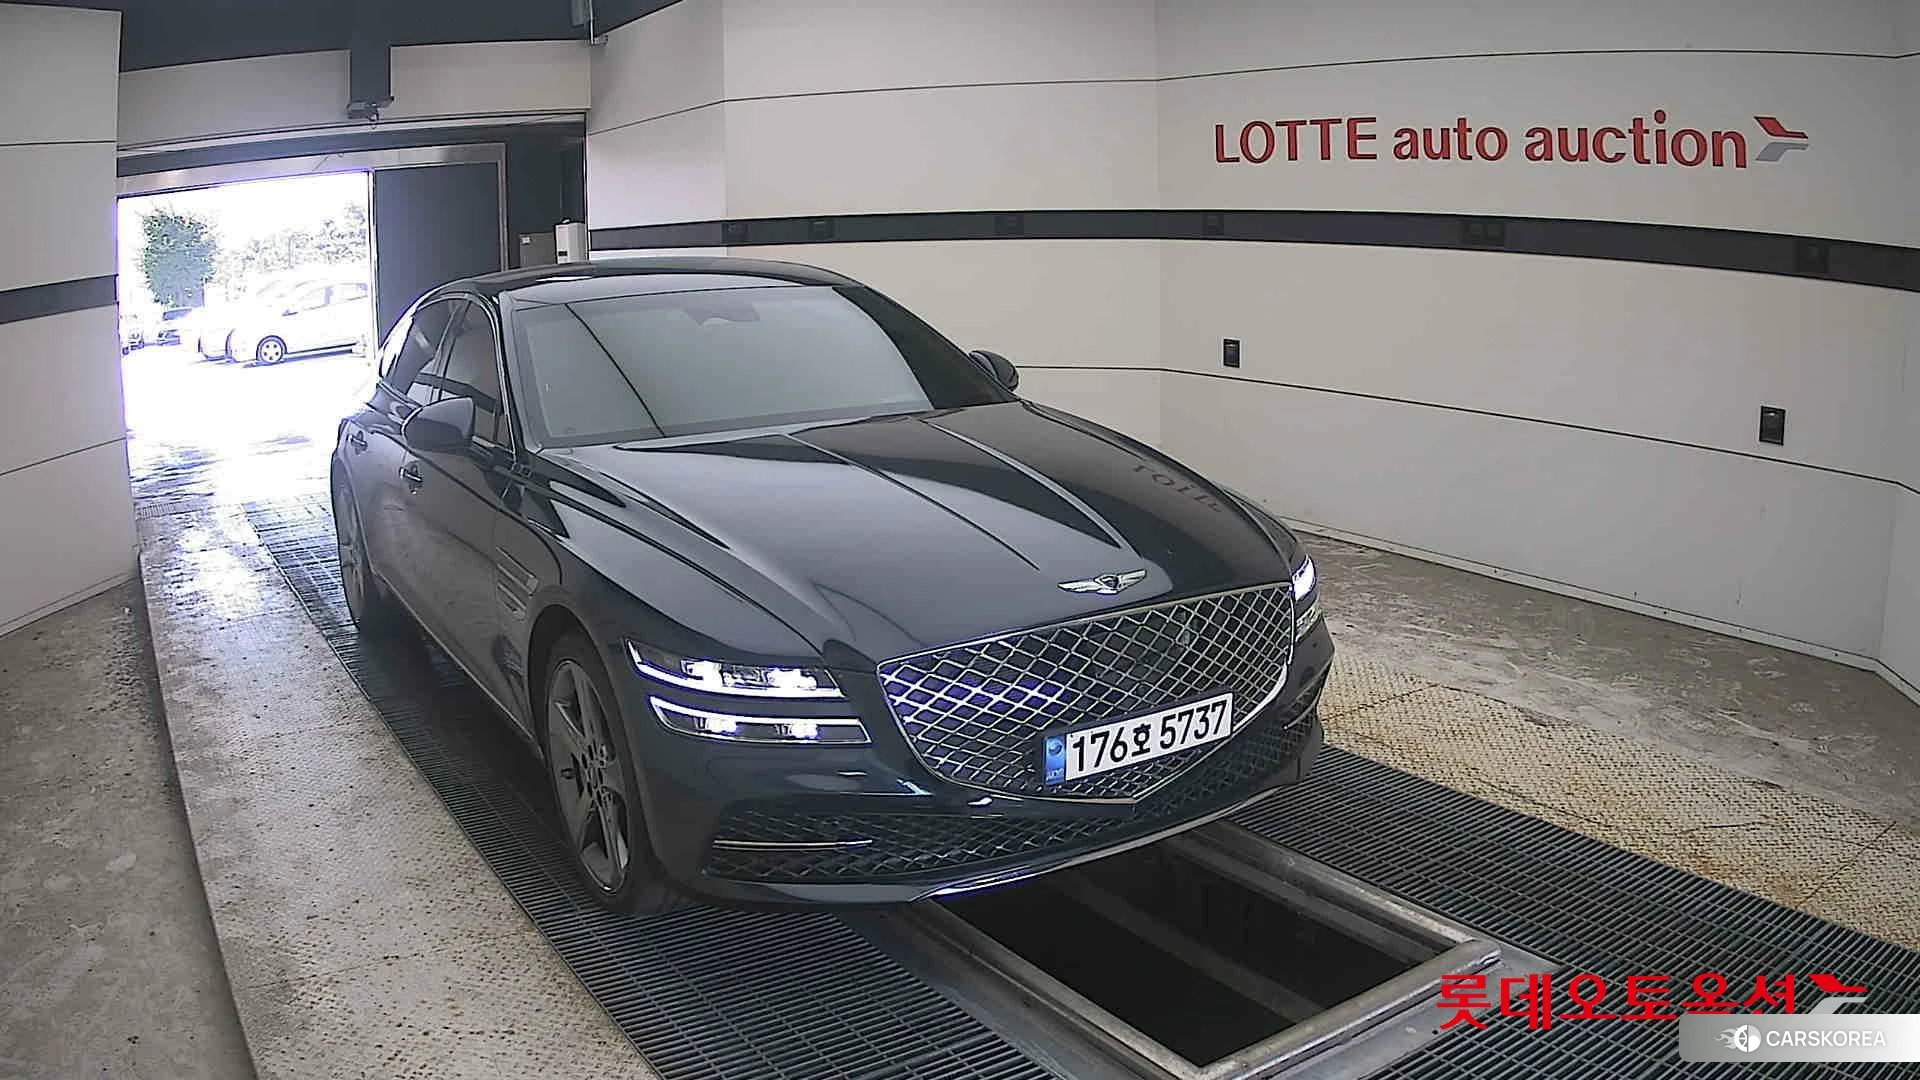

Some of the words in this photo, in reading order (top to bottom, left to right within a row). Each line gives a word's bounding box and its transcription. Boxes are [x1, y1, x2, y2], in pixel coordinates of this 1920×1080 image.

[1214, 116, 1378, 164] LOTTE
[1393, 116, 1508, 161] auto
[1523, 110, 1748, 169] auction
[1072, 723, 1151, 772] 176호
[1159, 700, 1227, 749] 5737
